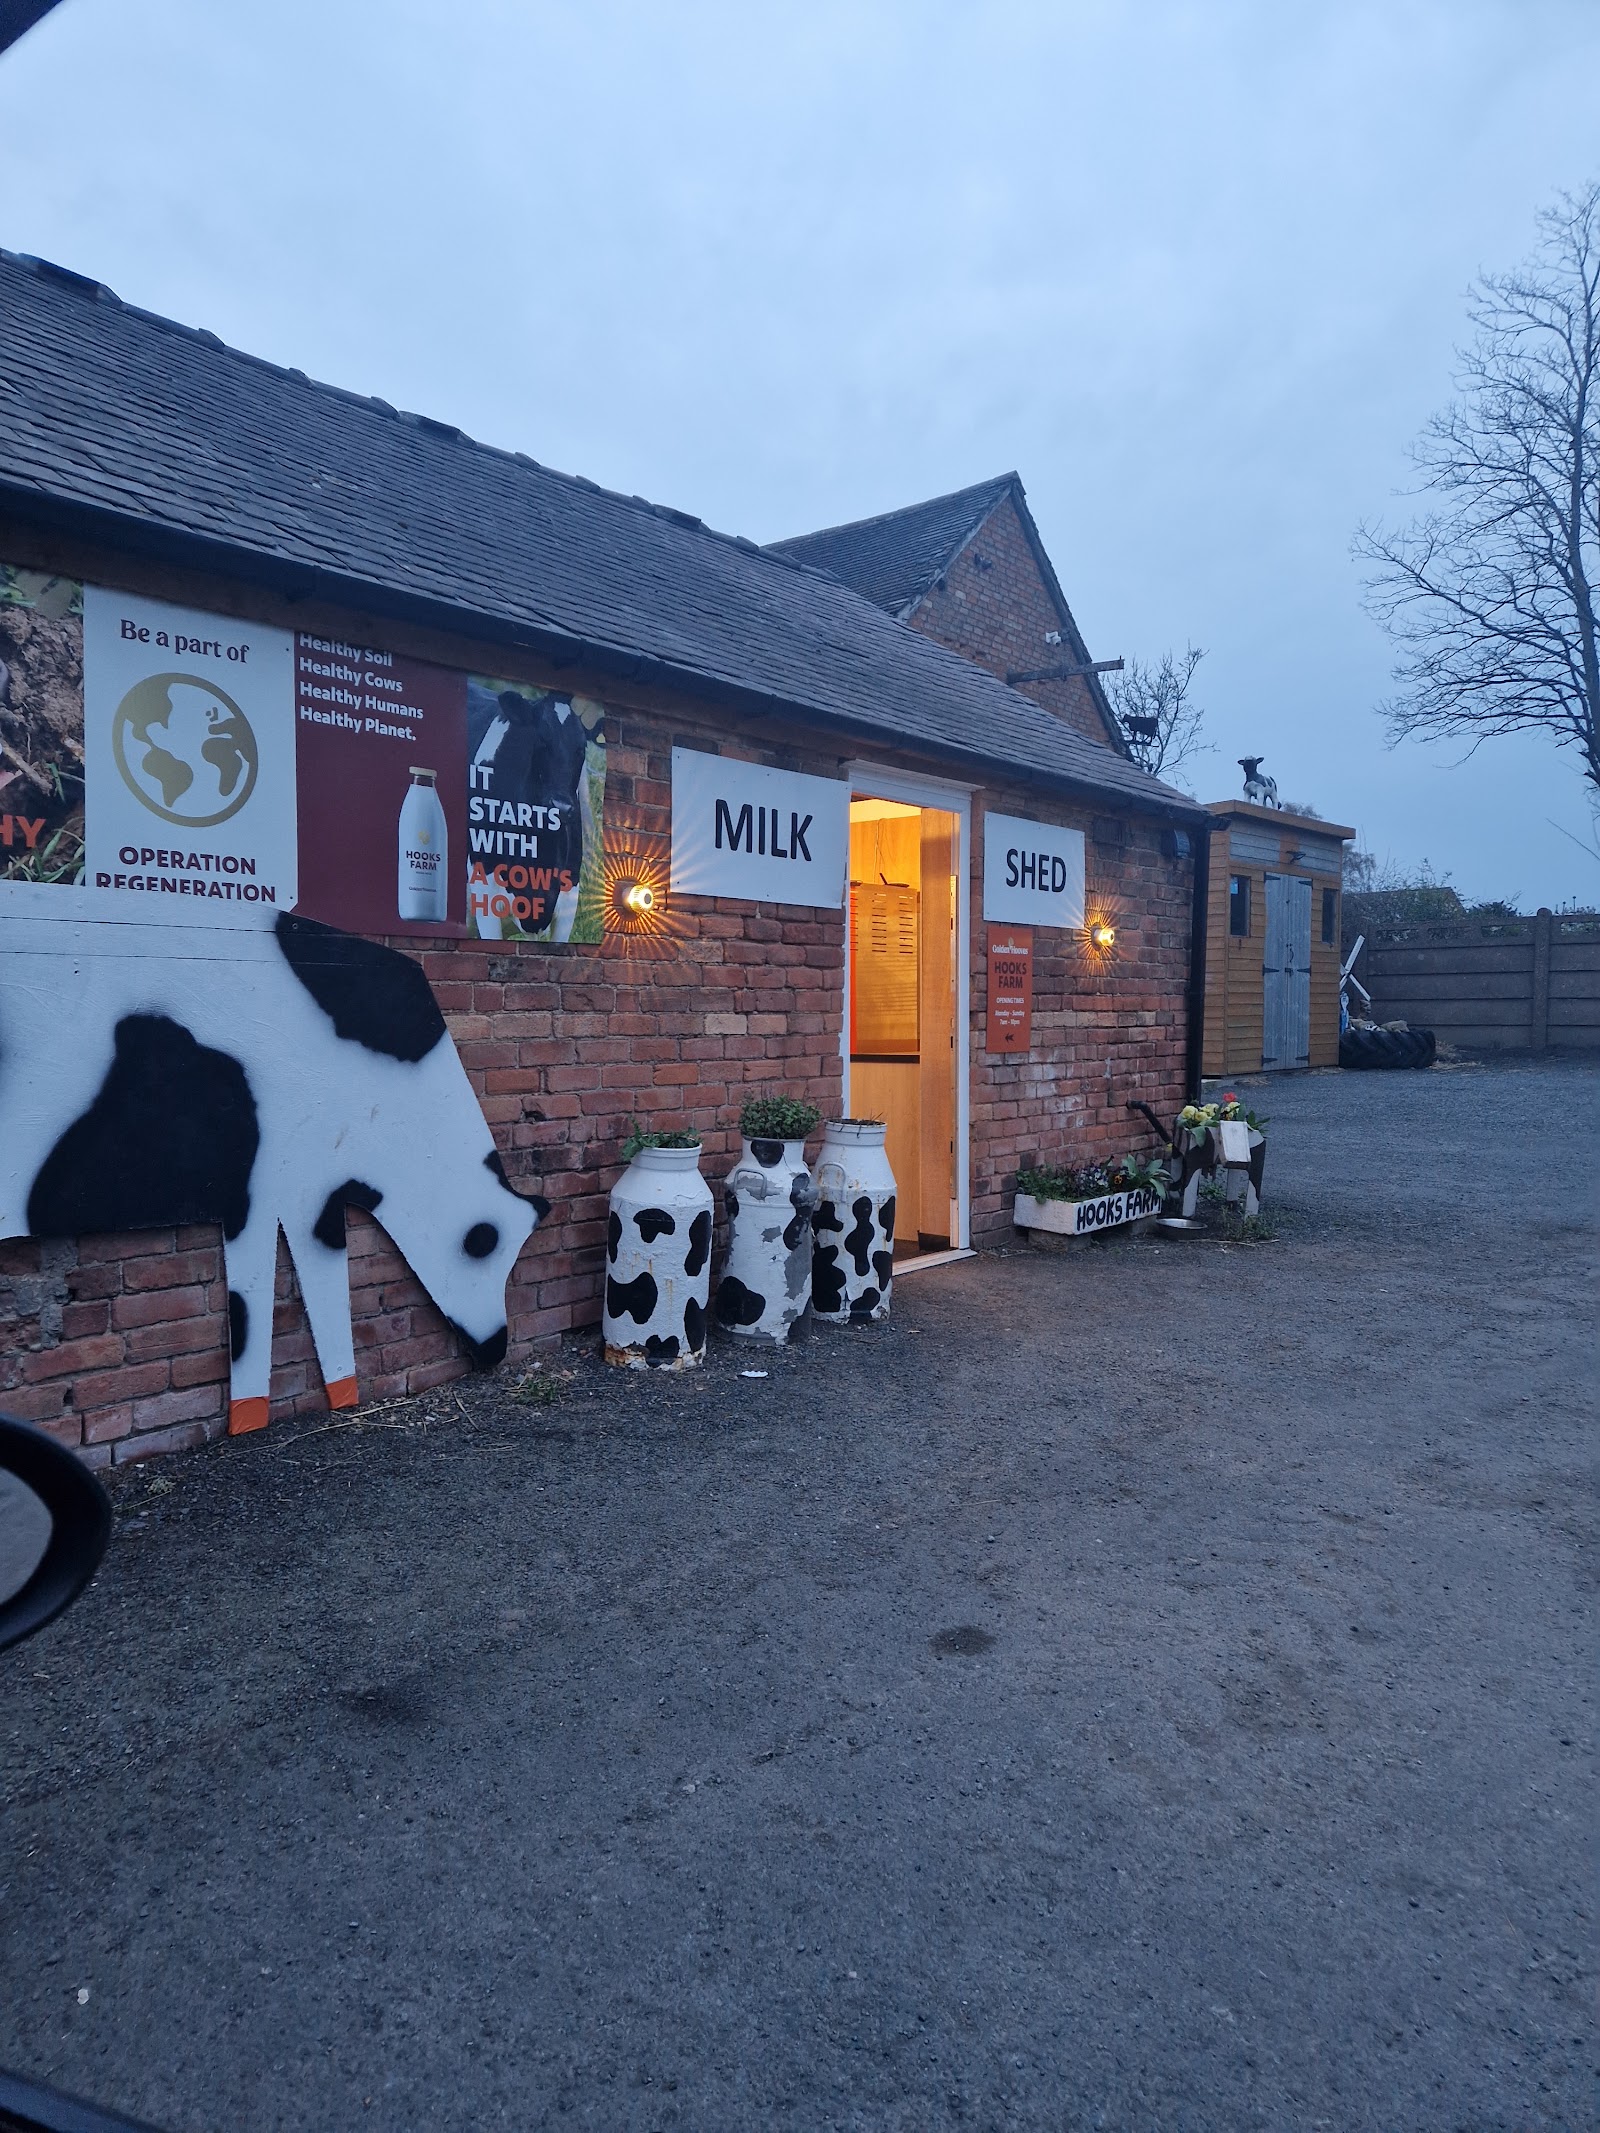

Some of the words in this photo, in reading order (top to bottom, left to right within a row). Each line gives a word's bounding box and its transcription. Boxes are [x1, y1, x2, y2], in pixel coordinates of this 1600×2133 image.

[120, 619, 150, 643] Be
[155, 631, 169, 647] a
[174, 635, 221, 658] part
[226, 644, 250, 664] of
[299, 632, 362, 663] Healthy
[364, 648, 393, 667] Soil
[299, 656, 362, 687] Healthy
[364, 671, 403, 693] Cows
[299, 680, 362, 710] Healthy
[365, 694, 424, 719] Humans
[300, 704, 363, 734] Healthy
[365, 717, 417, 741] Planet.
[468, 764, 494, 791] IT
[469, 796, 562, 831] STARTS
[468, 827, 538, 859] WITH
[714, 798, 814, 862] MILK
[118, 846, 256, 876] OPERATION
[405, 850, 441, 862] HOOKS
[410, 860, 437, 871] FARM
[1005, 848, 1067, 893] SHED
[95, 872, 276, 903] REGENERATION
[469, 861, 489, 886] A
[493, 863, 573, 892] COW'S
[470, 892, 545, 920] HOOF
[994, 961, 1027, 975] HOOKS
[998, 976, 1023, 989] FARM
[1076, 1196, 1123, 1231] HOOKS
[1125, 1188, 1162, 1218] FARM
